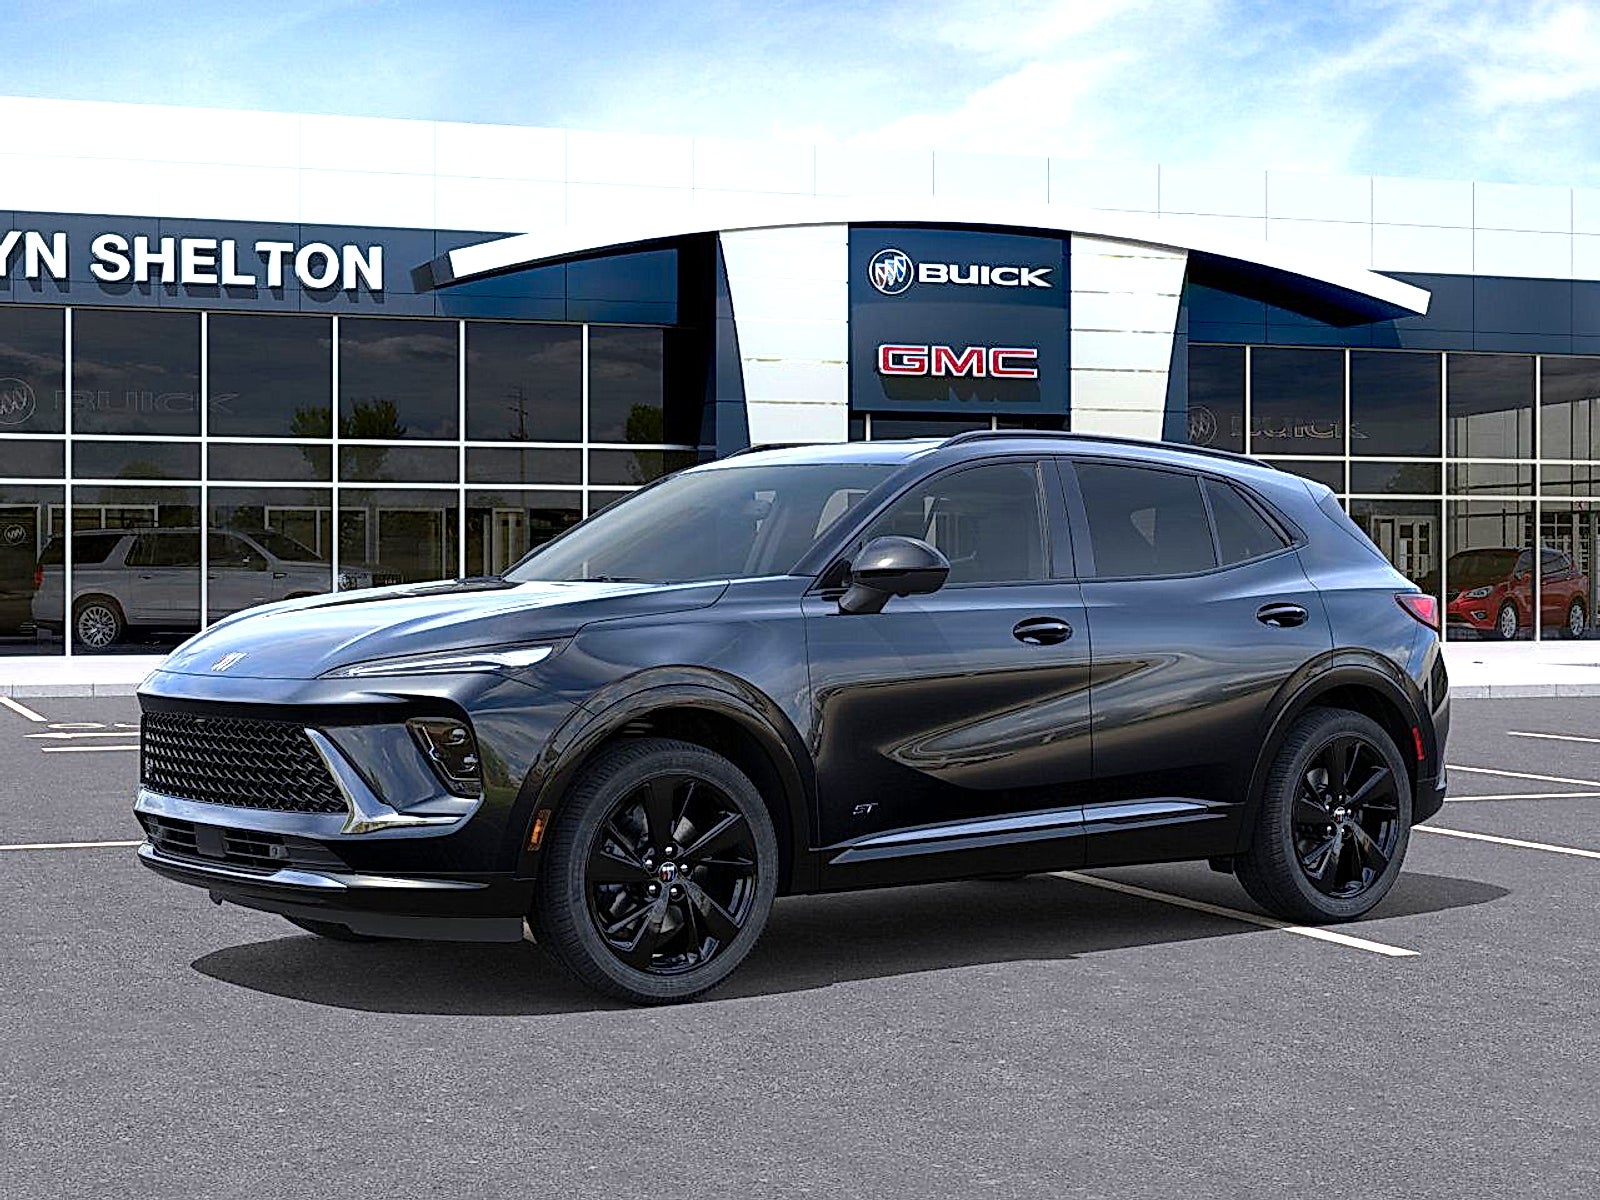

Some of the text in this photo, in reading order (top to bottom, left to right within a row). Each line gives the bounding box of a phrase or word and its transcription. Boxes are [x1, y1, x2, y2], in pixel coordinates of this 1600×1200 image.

[90, 233, 383, 290] SHELTON
[918, 263, 1053, 288] BUICK
[878, 344, 1039, 379] GMC
